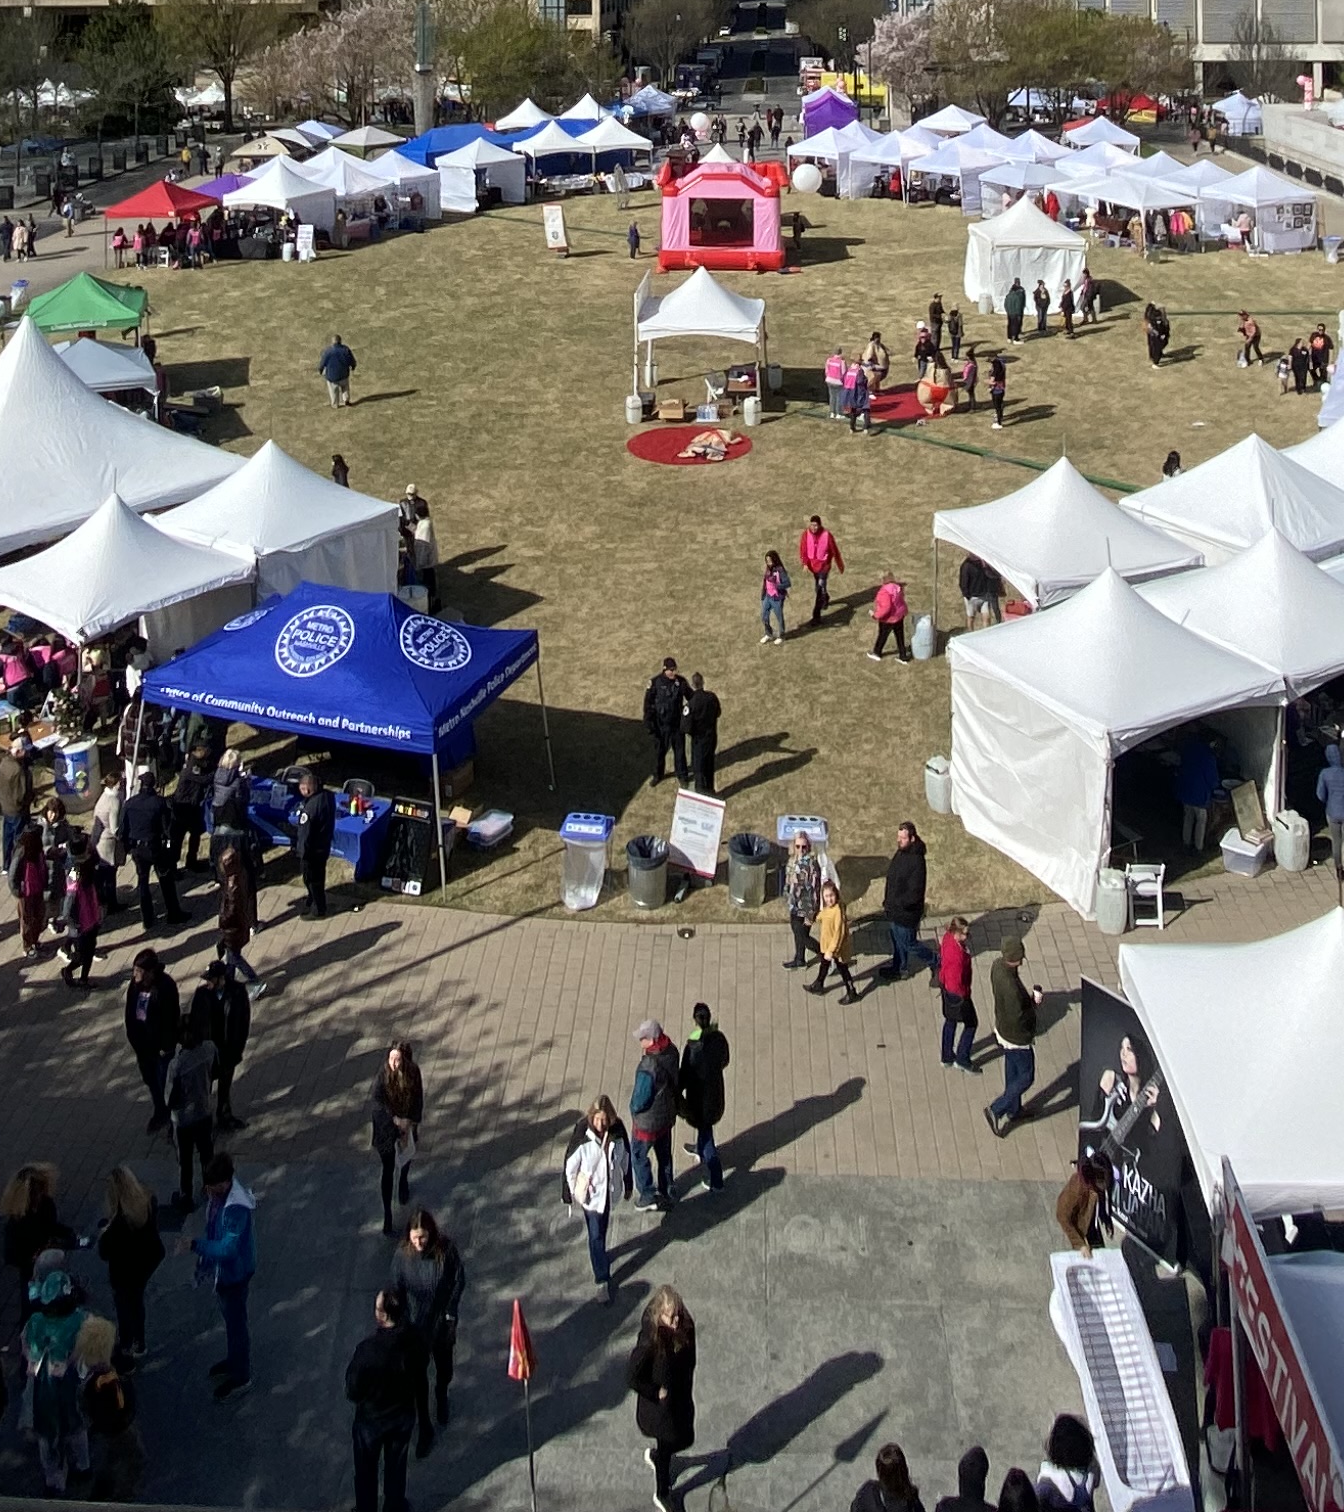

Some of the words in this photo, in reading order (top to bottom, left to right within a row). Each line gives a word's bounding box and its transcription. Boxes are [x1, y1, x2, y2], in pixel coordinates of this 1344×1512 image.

[291, 628, 338, 647] POLICE
[306, 621, 334, 634] METRO
[418, 627, 452, 657] POLICE
[192, 691, 205, 702] of
[205, 694, 265, 716] Community
[267, 706, 316, 725] Outreach
[318, 716, 340, 729] and
[341, 718, 411, 740] Partnerships
[1123, 1162, 1166, 1222] KAZHA
